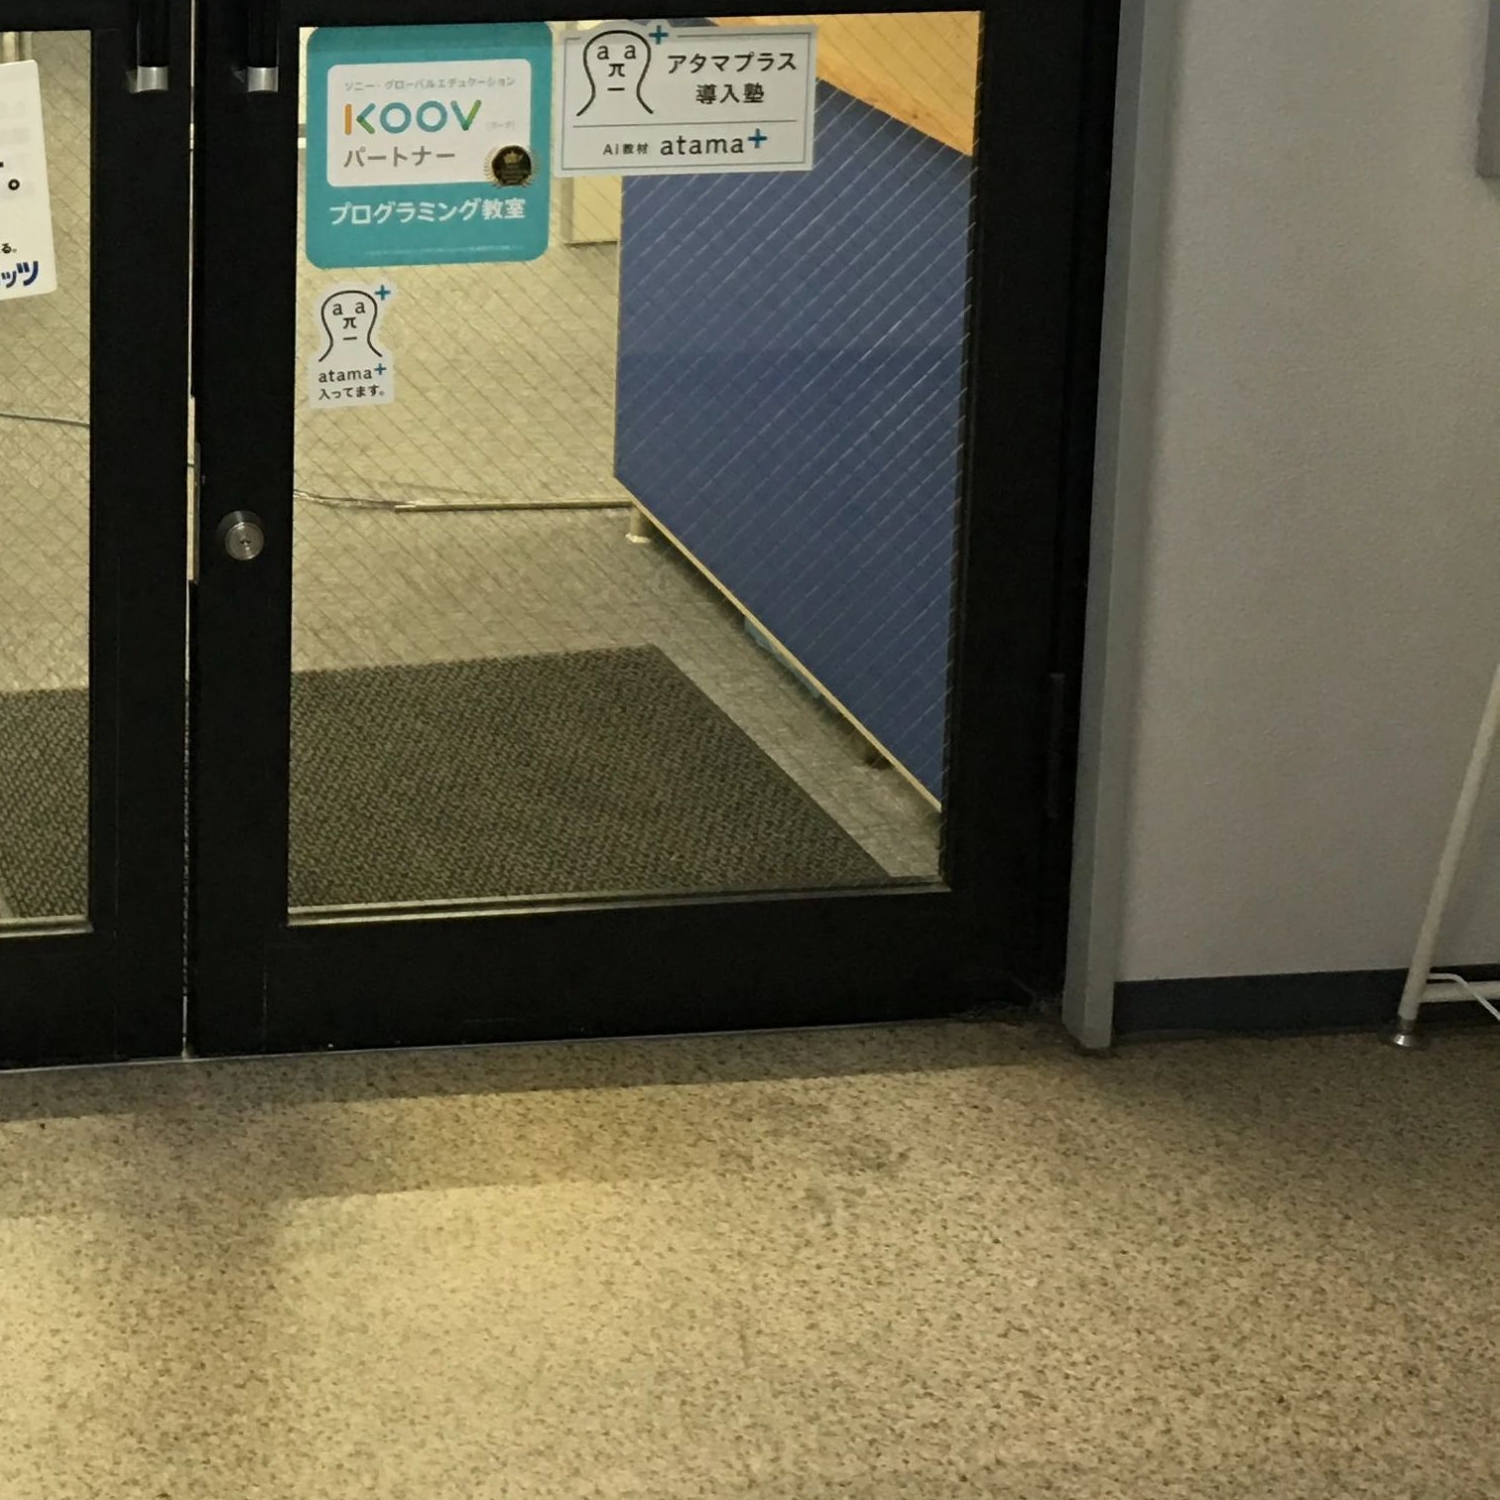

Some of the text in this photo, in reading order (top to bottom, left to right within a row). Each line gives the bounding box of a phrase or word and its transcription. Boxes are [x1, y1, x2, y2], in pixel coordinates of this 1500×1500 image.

[667, 52, 797, 75] アタマプラス
[695, 82, 765, 105] 導入塾
[345, 99, 482, 136] KOOV
[344, 146, 455, 168] パートナー
[329, 197, 526, 226] プログラミング教室
[318, 384, 385, 401] 入ってます。
